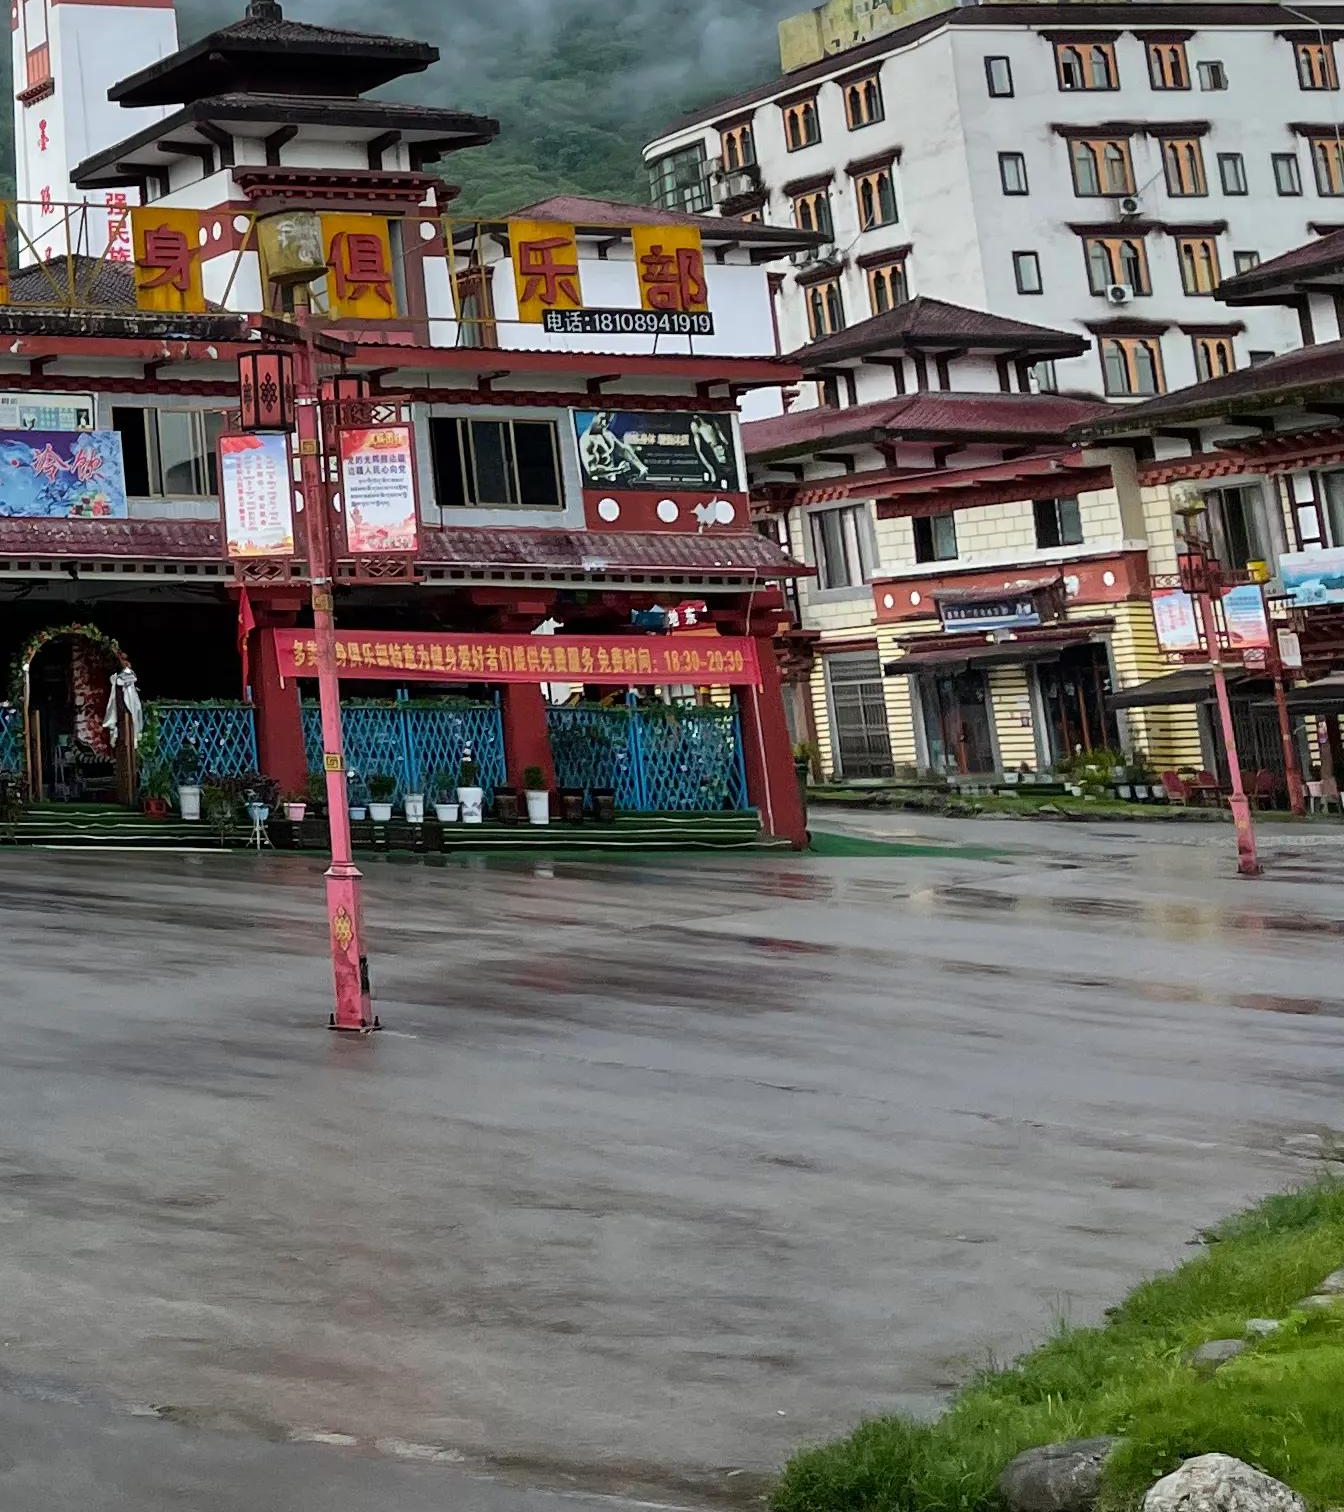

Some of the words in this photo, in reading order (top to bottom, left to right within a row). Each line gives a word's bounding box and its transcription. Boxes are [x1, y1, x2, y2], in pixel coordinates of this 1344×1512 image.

[293, 640, 593, 674] 多美身俱乐部特意为健身爱好者们提供免费服务
[663, 649, 744, 673] 18:30-20:30
